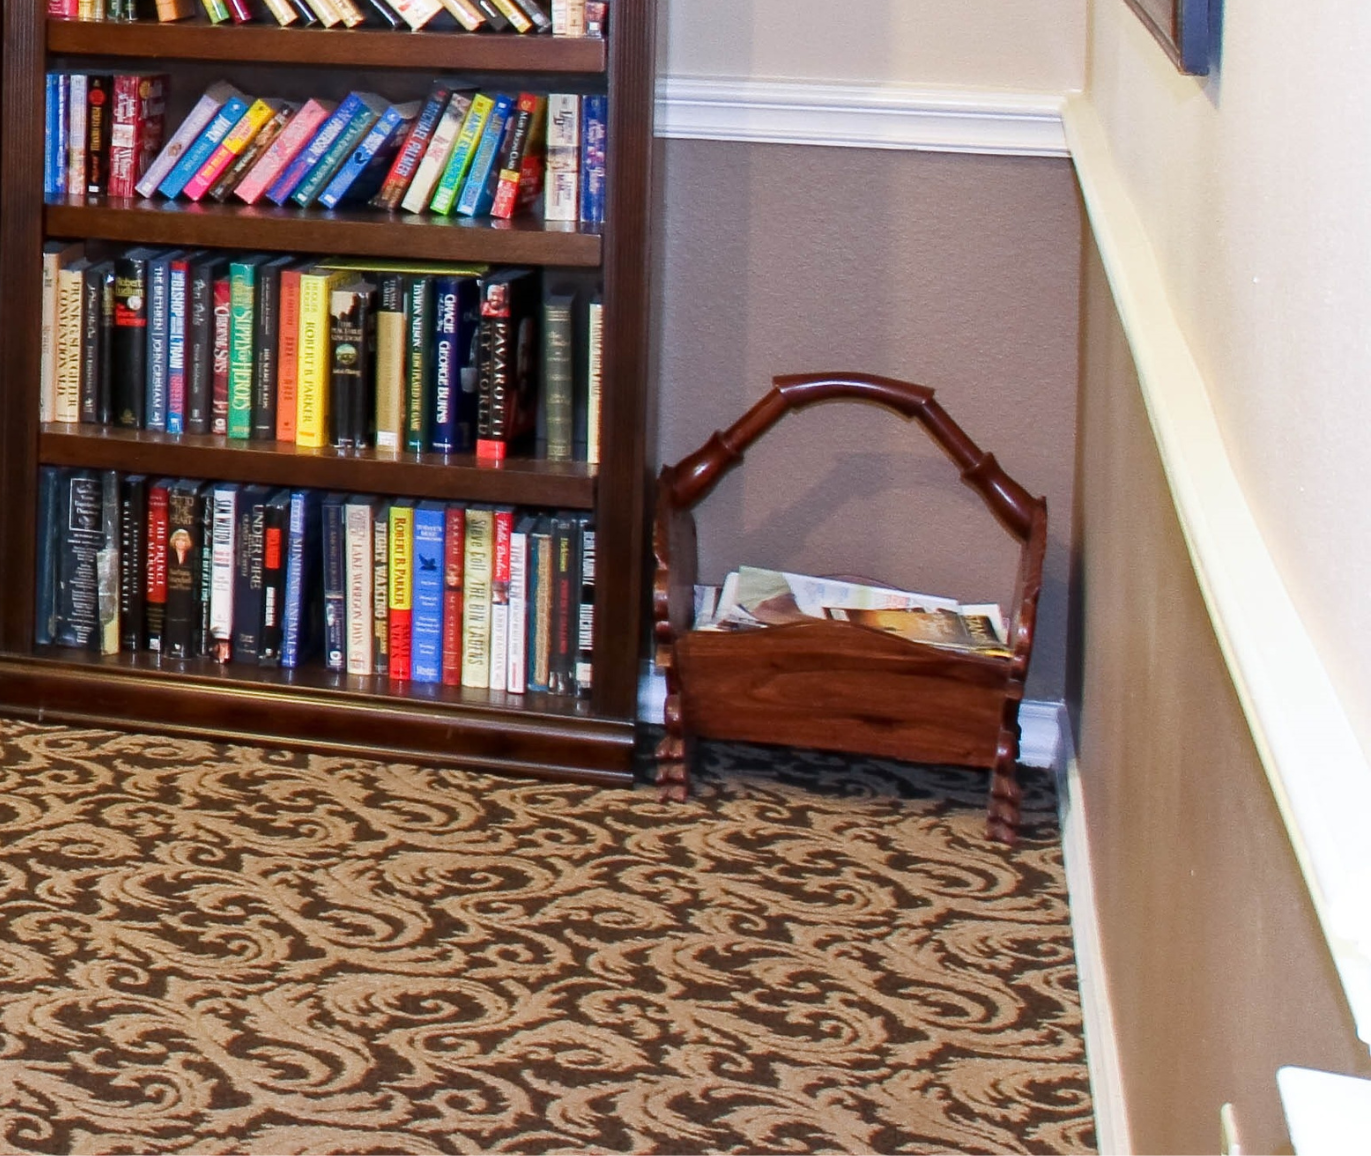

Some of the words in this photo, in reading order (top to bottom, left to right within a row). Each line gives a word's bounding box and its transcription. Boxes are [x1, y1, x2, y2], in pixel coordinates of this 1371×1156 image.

[412, 102, 436, 139] MICHAEL
[395, 141, 425, 177] PALMER
[154, 266, 163, 284] THE
[70, 282, 80, 321] FRANK
[154, 286, 163, 330] BRETHREN
[170, 279, 184, 317] BISHOP
[412, 284, 421, 315] BYRON
[444, 294, 456, 333] GRACIE
[59, 289, 70, 368] CONVENTION
[233, 309, 252, 350] SUPPLY
[303, 322, 314, 368] ROBERT
[412, 316, 421, 347] NELSON
[481, 322, 491, 351] MY
[153, 339, 162, 363] JOHN
[170, 341, 184, 368] TRAIN
[437, 341, 451, 386] GEORGE
[67, 337, 78, 407] SLAUGHTER
[152, 364, 161, 407] GRISHAM
[232, 362, 252, 410] HEROES
[493, 322, 507, 437] PAVAROTTI
[302, 380, 314, 422] PARKER
[436, 387, 449, 423] BURNS
[478, 361, 490, 435] WORLD
[157, 521, 165, 540] THE
[251, 504, 264, 554] UNDER
[374, 521, 386, 562] NIGHT
[394, 518, 407, 554] ROBERT
[470, 519, 486, 547] Steve
[156, 545, 164, 586] PRINCE
[250, 557, 262, 589] FIRE
[291, 538, 302, 595] MINDING
[352, 543, 364, 569] LAKE
[394, 557, 406, 567] B.
[470, 552, 486, 571] Coll
[352, 573, 364, 619] WOBEGON
[374, 565, 386, 618] WAKING
[393, 569, 406, 605] PARKER
[469, 581, 485, 600] THE
[287, 602, 299, 654] ANIMALS
[469, 604, 484, 621] BIN
[352, 622, 364, 645] DAYS
[468, 626, 484, 666] LADENS
